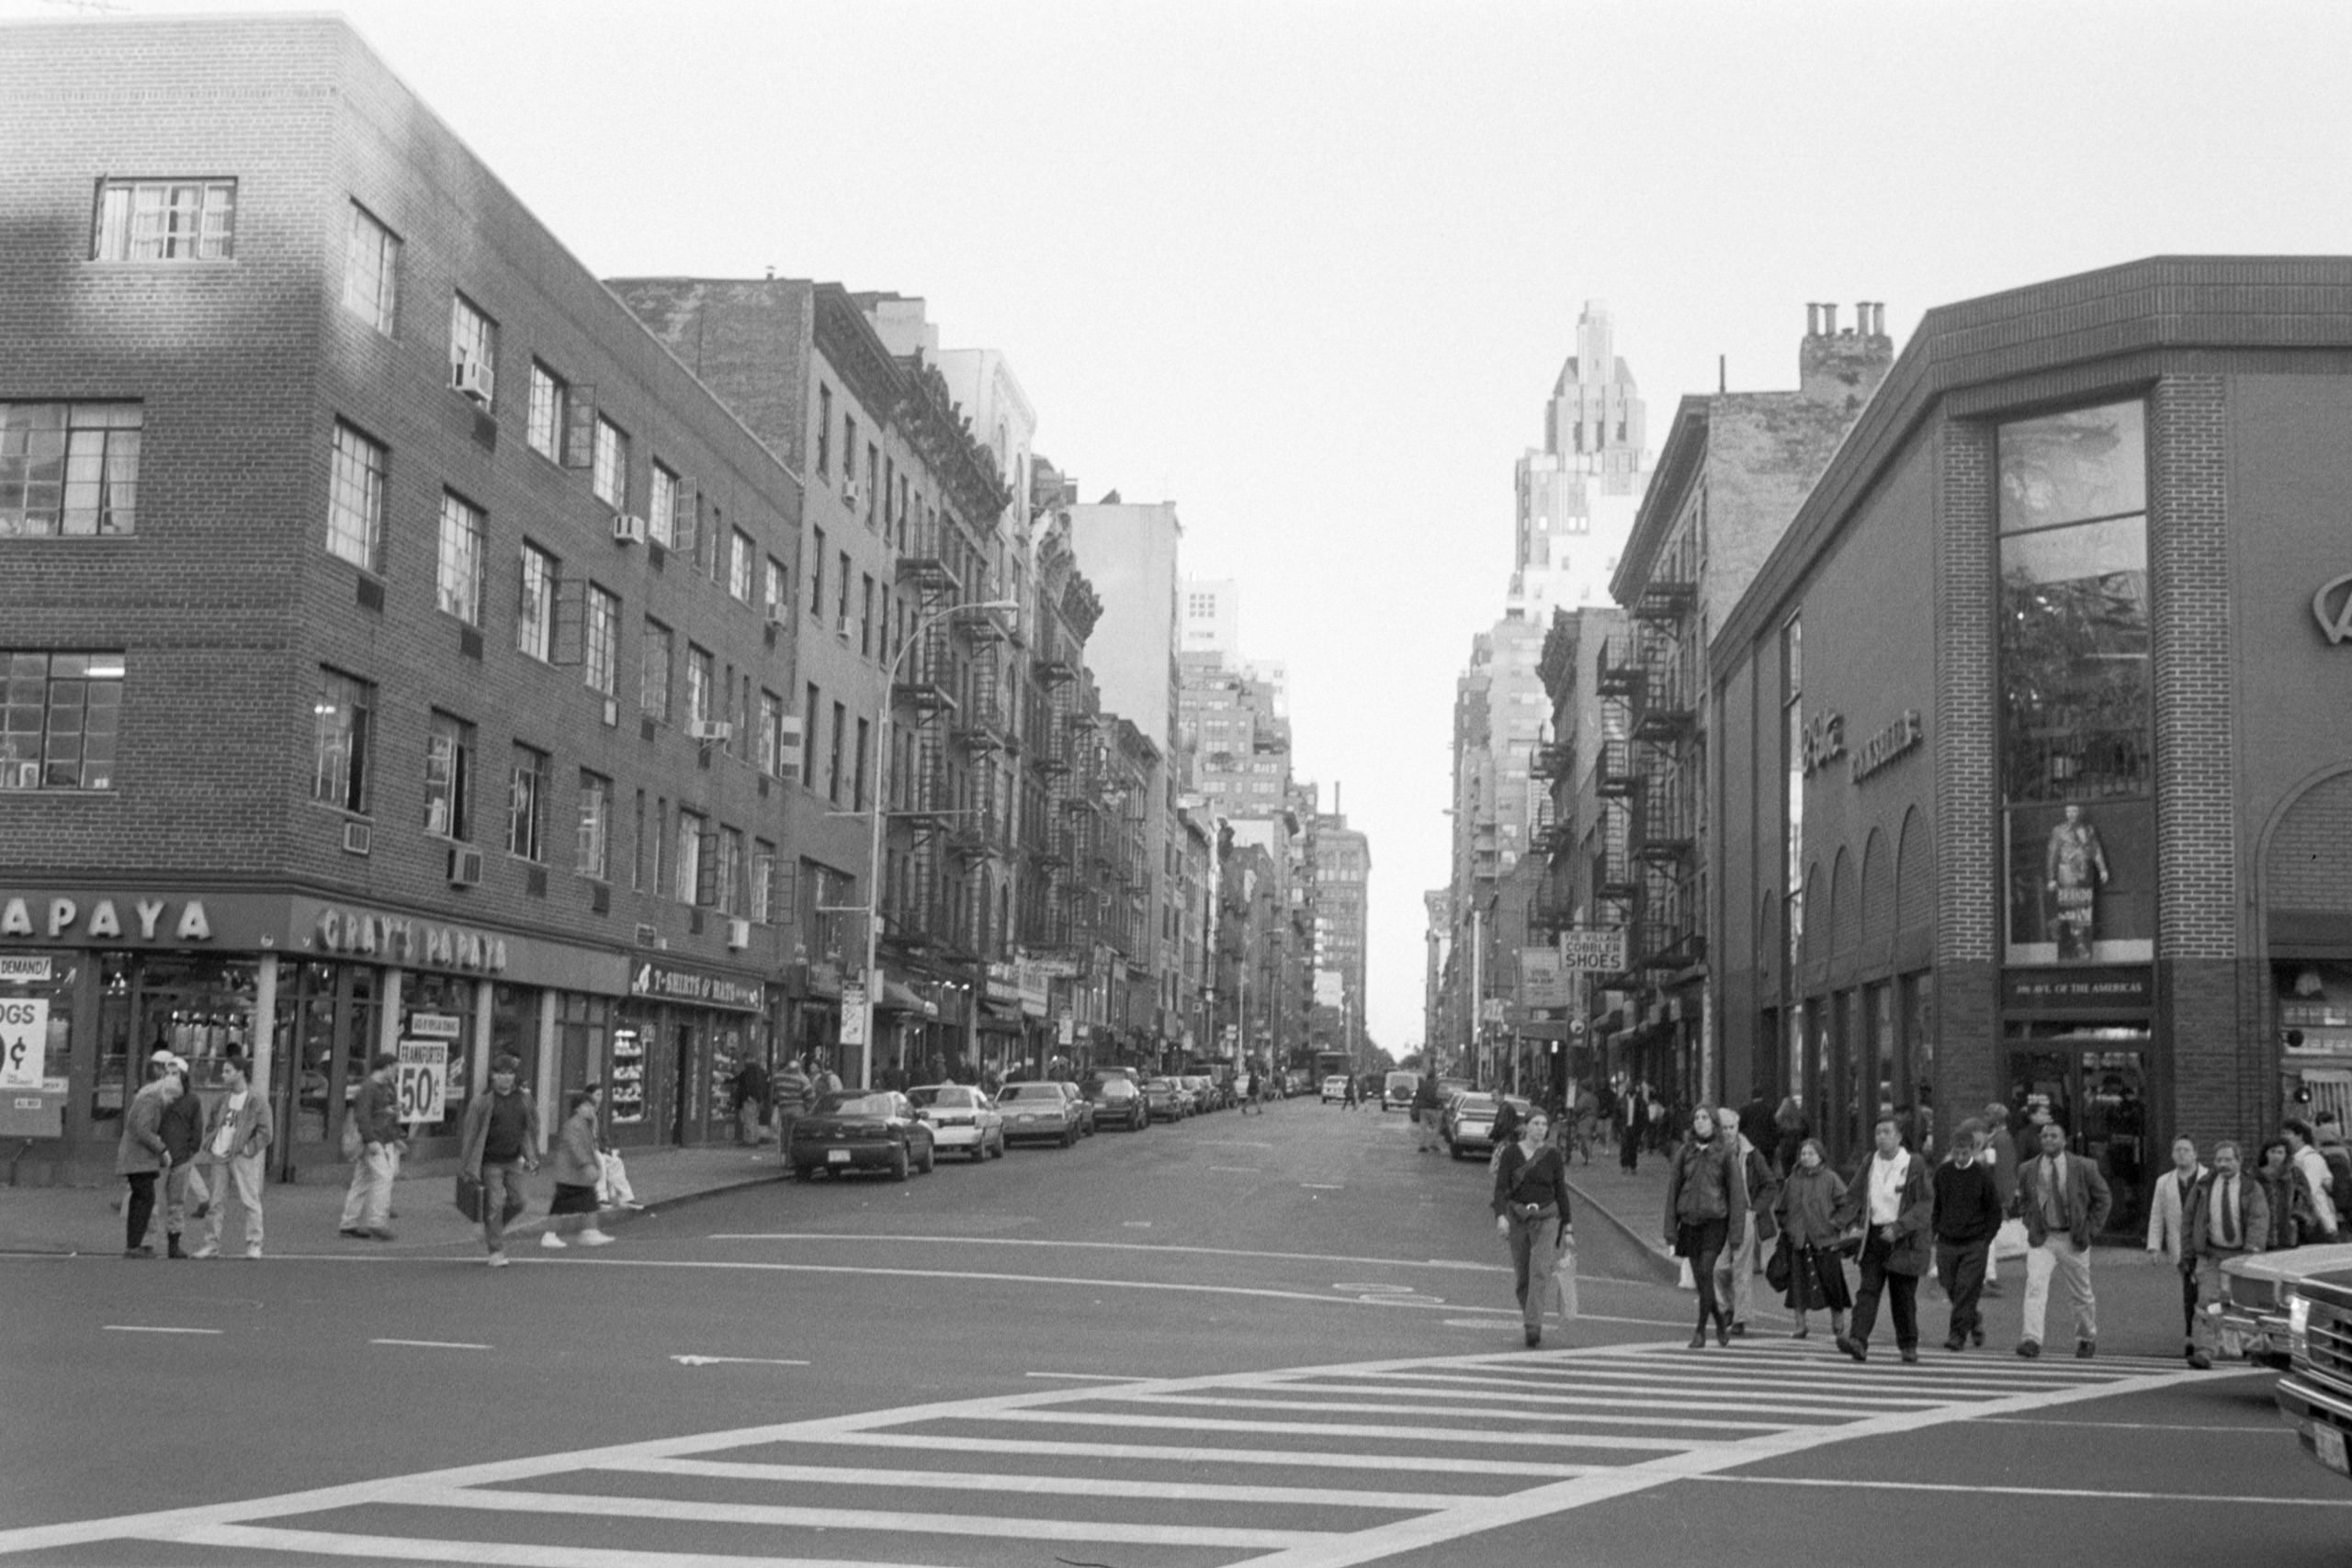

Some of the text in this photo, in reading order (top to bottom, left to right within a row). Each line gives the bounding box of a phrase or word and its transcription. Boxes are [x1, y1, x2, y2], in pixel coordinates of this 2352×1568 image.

[419, 927, 506, 970] PAPAYA
[1566, 942, 1622, 953] COBBLER
[1, 960, 50, 976] DEMAND!
[1566, 953, 1622, 969] SHOES
[654, 969, 701, 997] T-SHIRTS
[711, 978, 736, 1002] HATS
[2054, 984, 2067, 993] OF
[2071, 983, 2089, 993] THE
[2091, 982, 2143, 993] AMERICAS
